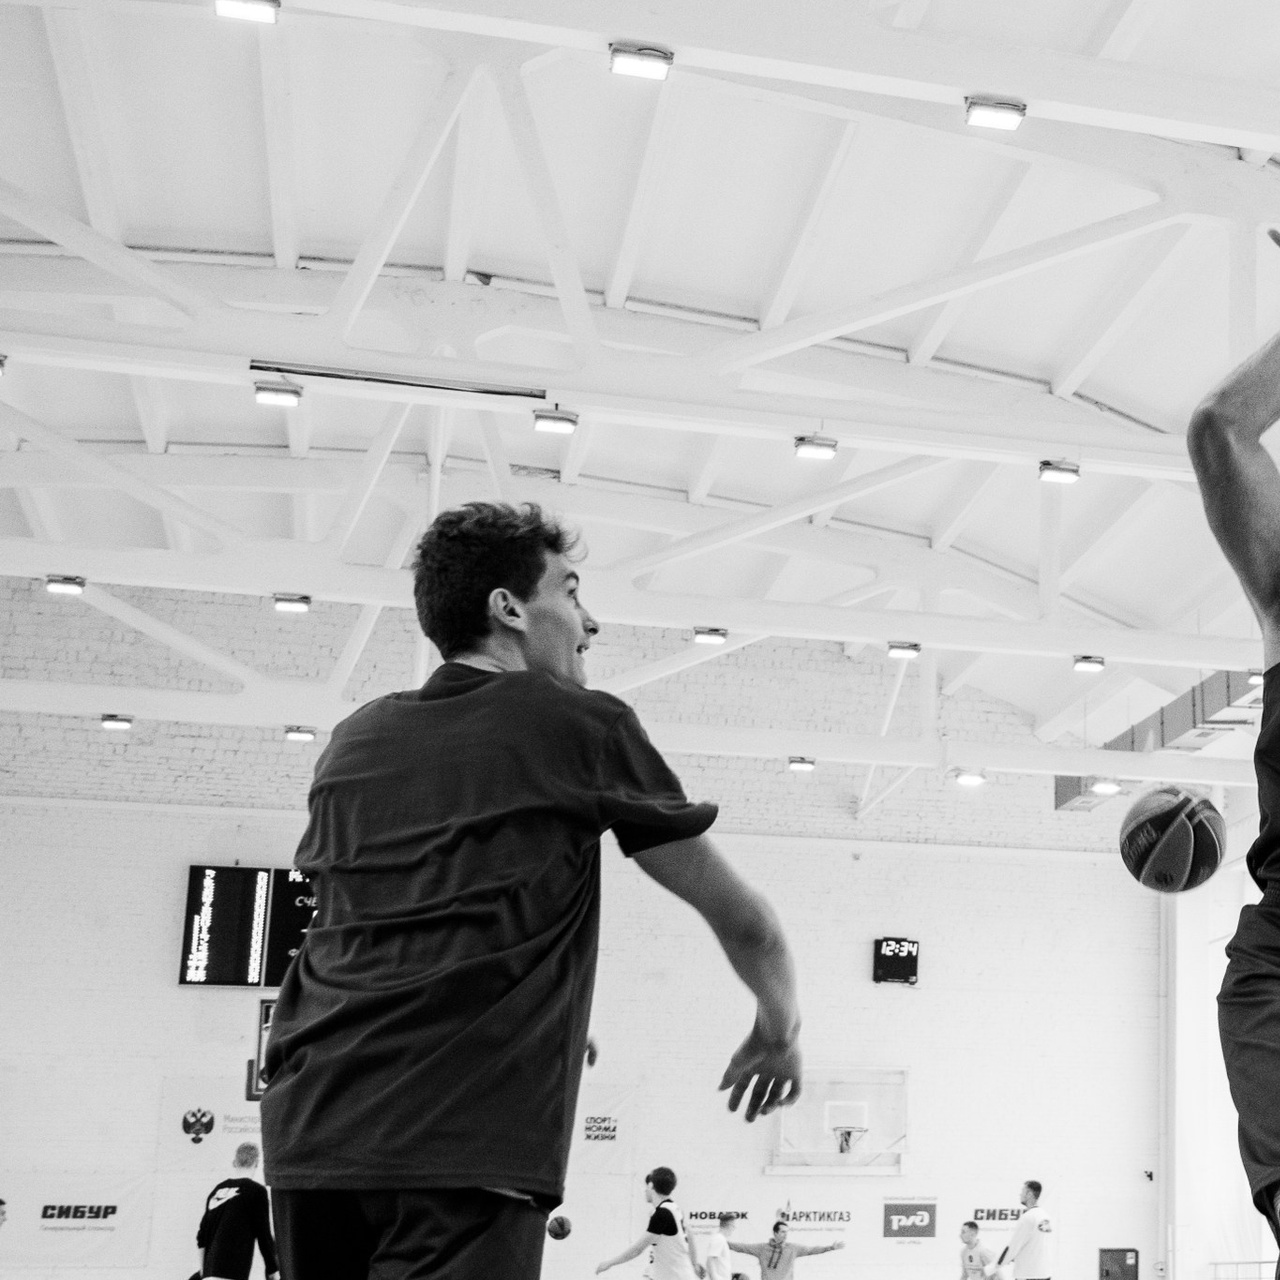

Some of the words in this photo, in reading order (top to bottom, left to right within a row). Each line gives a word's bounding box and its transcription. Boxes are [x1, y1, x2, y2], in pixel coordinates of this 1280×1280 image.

[881, 940, 919, 957] 12:34
[41, 1204, 118, 1220] СИБУР
[791, 1210, 852, 1223] АРКТИКГАЗ
[974, 1208, 1028, 1221] СИБУ
